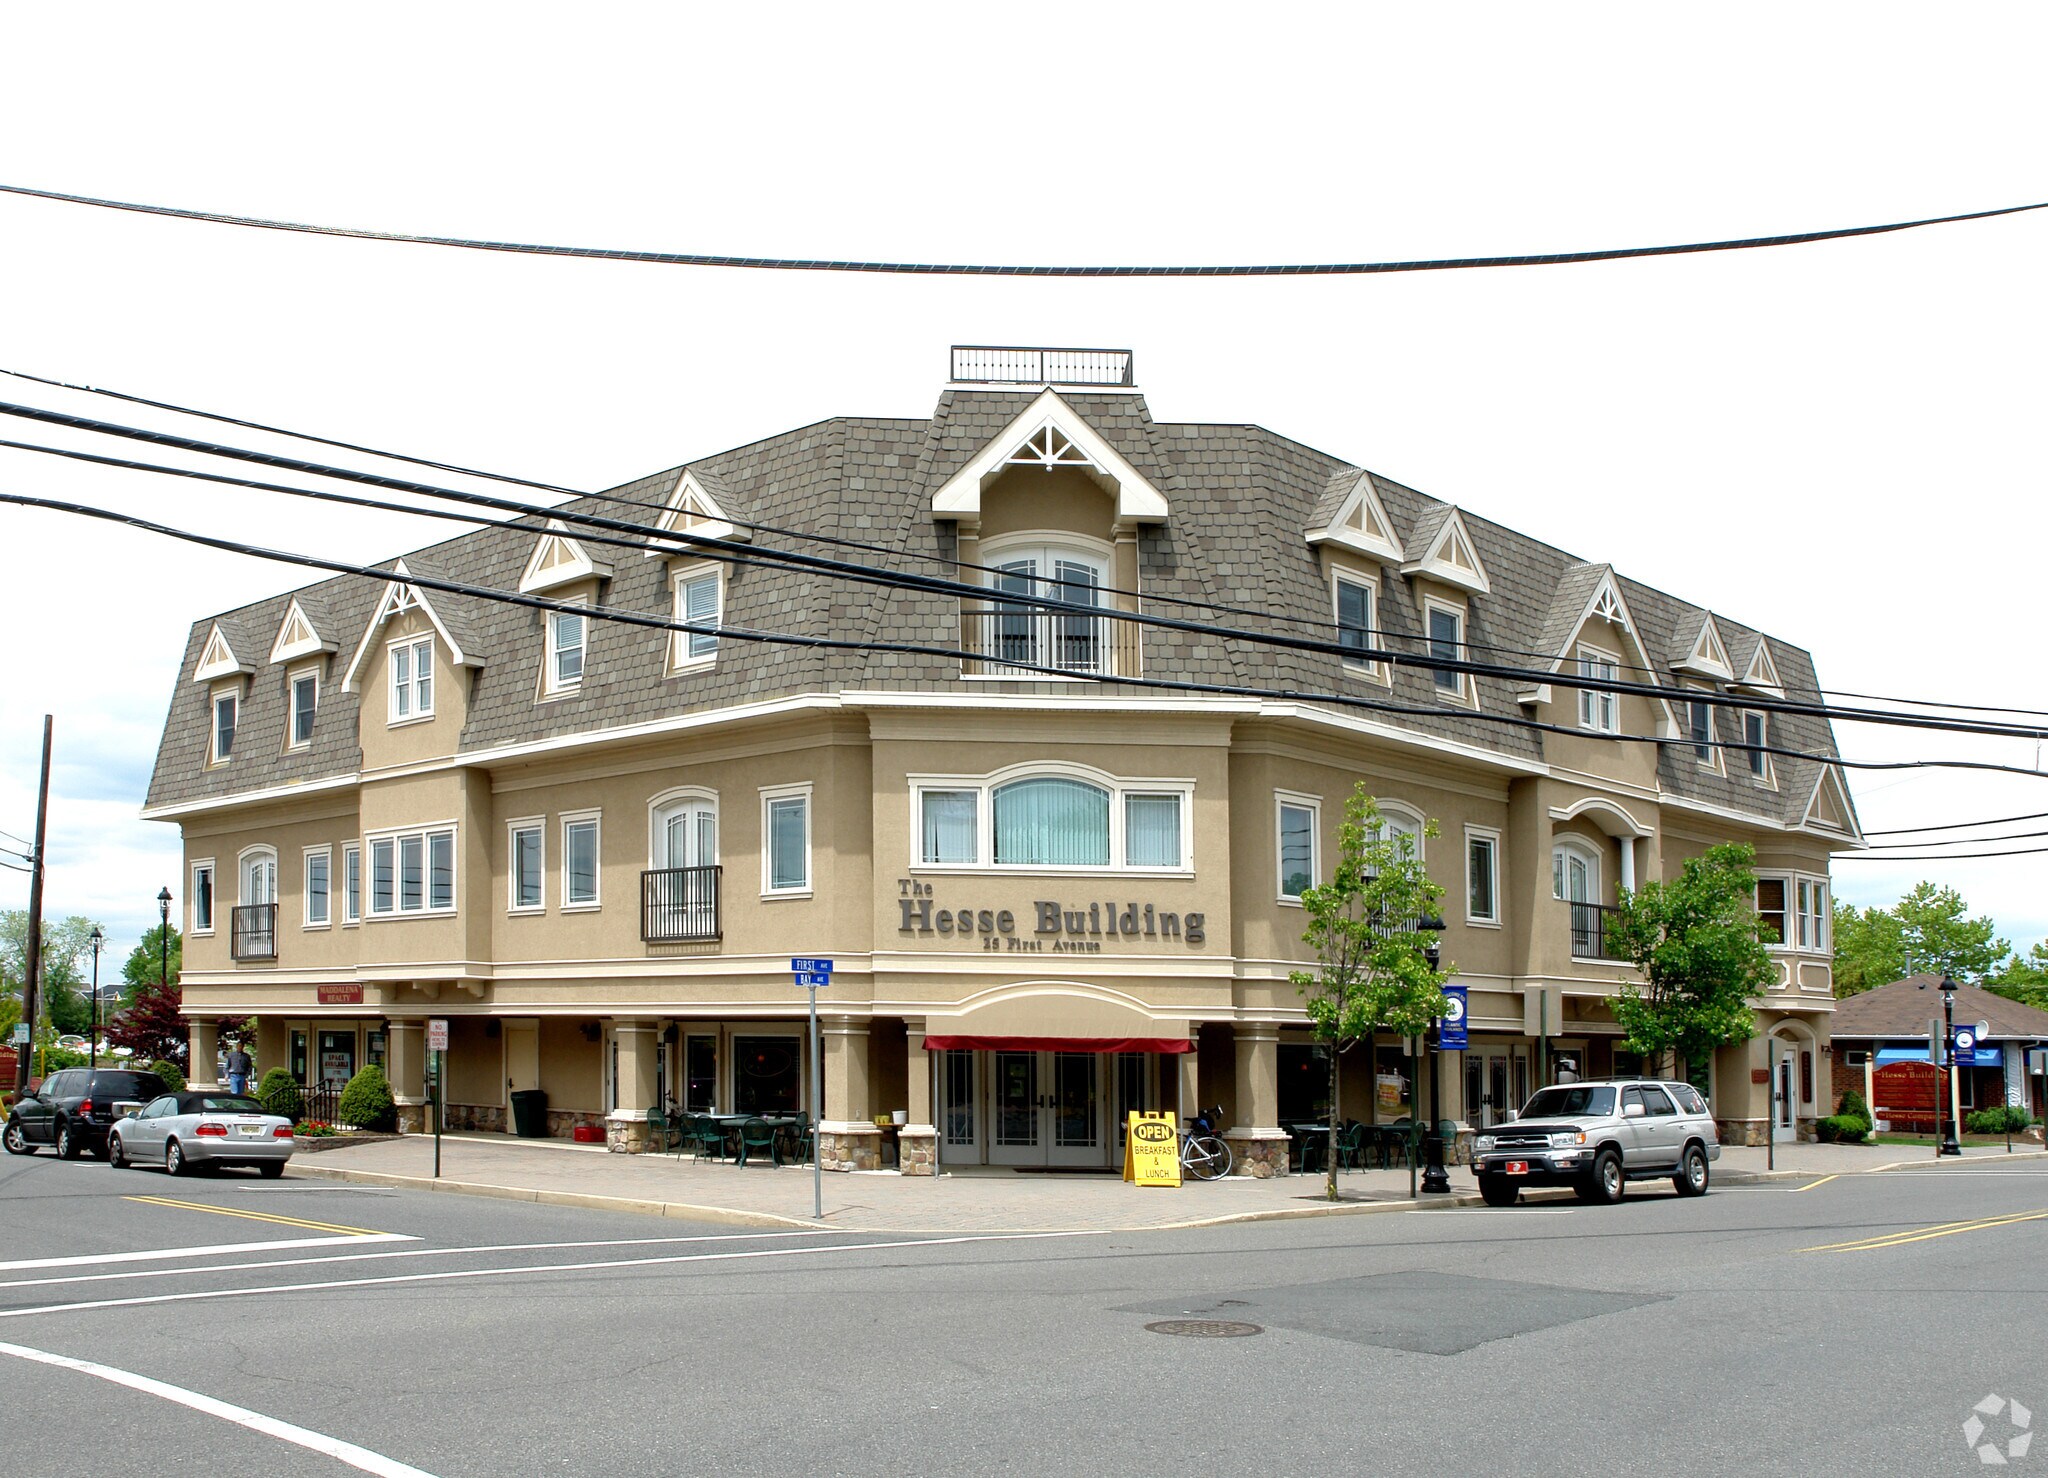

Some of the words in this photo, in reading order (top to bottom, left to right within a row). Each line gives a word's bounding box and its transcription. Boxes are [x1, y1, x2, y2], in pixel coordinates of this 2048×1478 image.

[898, 879, 933, 895] The
[898, 899, 1015, 933] Hesse
[1034, 900, 1205, 943] Building
[1007, 937, 1042, 951] First
[1053, 939, 1101, 952] Avenue
[796, 960, 815, 970] FIRST
[800, 974, 811, 985] BAY
[320, 986, 358, 994] MADDALENA
[327, 994, 351, 1002] REALTY
[1881, 1071, 1907, 1079] Hesse
[1909, 1071, 1948, 1079] Buildng
[1907, 1112, 1947, 1121] Companes
[1138, 1125, 1170, 1139] OPEN
[1134, 1146, 1176, 1156] BREAKFAST
[1153, 1156, 1159, 1166] &
[1145, 1169, 1170, 1178] LUNCH
